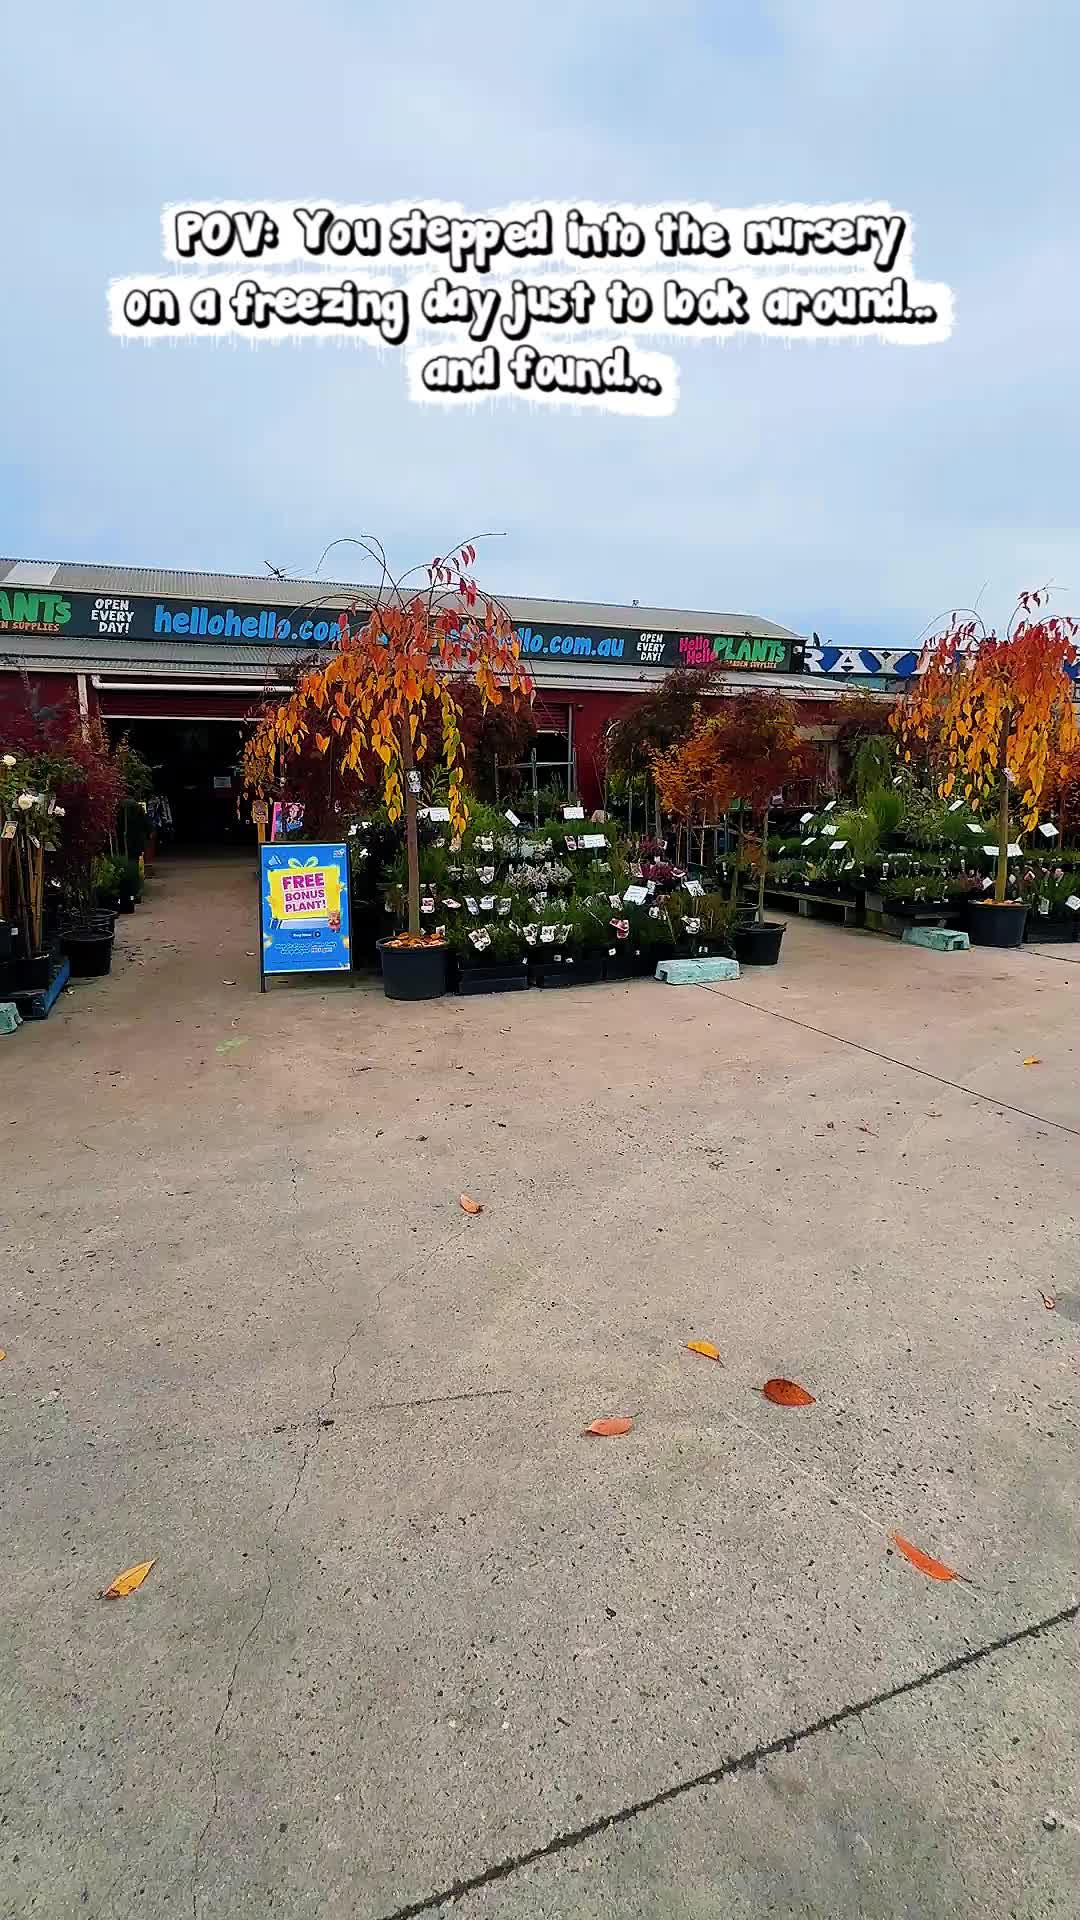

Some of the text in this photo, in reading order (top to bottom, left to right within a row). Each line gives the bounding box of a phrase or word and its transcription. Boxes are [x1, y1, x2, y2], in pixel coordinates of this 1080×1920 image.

[95, 598, 129, 610] OPEN
[91, 610, 135, 622] EVERY
[99, 621, 130, 633] DAY!
[640, 633, 663, 643] OPEN
[679, 636, 710, 652] Hello
[636, 643, 666, 652] EVERY
[640, 651, 662, 662] DAY!
[281, 872, 325, 890] FREE
[284, 889, 325, 902] BONUS
[285, 899, 326, 913] PLANT!
